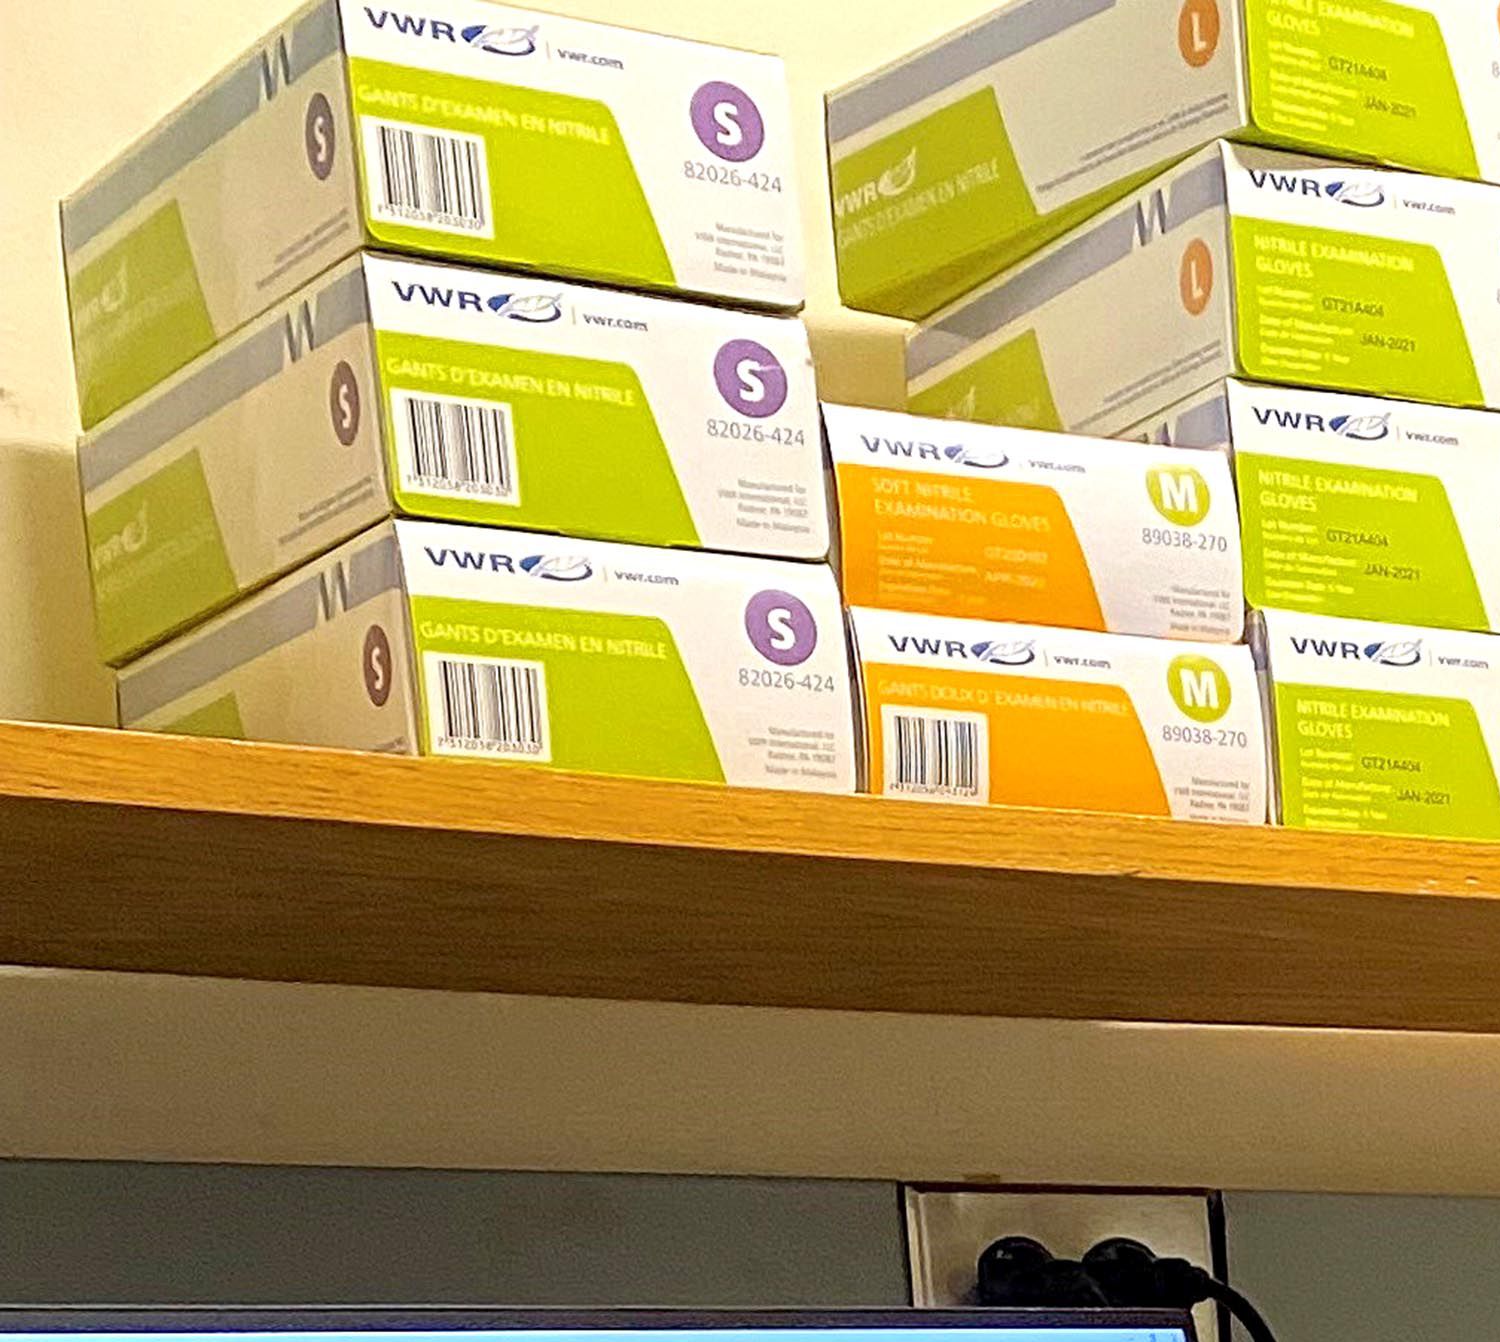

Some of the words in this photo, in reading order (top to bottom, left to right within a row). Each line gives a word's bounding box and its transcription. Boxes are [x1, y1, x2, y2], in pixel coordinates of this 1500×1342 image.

[363, 6, 456, 43] VWR
[557, 49, 624, 70] vwr.com
[1191, 4, 1207, 51] L
[357, 84, 418, 114] GANTS
[521, 113, 545, 132] EN
[547, 117, 611, 146] NITRILE
[711, 102, 743, 146] S
[315, 117, 326, 161] S
[683, 160, 783, 193] 82026-424
[1249, 169, 1322, 198] VWR
[835, 182, 877, 217] VWR
[1254, 235, 1309, 257] NITRILE
[1191, 254, 1203, 297] L
[1255, 256, 1313, 278] GLOVES
[391, 281, 484, 313] VWR
[583, 314, 648, 331] vwr.com
[386, 358, 446, 383] GANTS
[547, 379, 571, 397] EN
[574, 382, 636, 406] NITRILE
[736, 359, 765, 402] S
[339, 384, 351, 426] S
[1251, 406, 1325, 432] VWR
[707, 419, 805, 447] 82026-424
[860, 434, 941, 461] VWR
[872, 476, 910, 495] SOFT
[914, 479, 973, 503] NITRILE
[1159, 471, 1198, 513] M
[1258, 468, 1312, 492] NITRILE
[874, 499, 987, 526] EXAMINATION
[991, 509, 1051, 533] GLOVES
[1260, 492, 1317, 512] GLOVES
[1142, 527, 1228, 553] 89038-270
[424, 546, 515, 573] VWR
[614, 570, 679, 586] vwr.com
[420, 622, 479, 644] GANTS
[579, 636, 603, 653] EN
[607, 639, 666, 659] NITRILE
[767, 608, 795, 650] S
[889, 635, 966, 660] VWR
[1290, 637, 1360, 661] VWR
[371, 647, 383, 688] S
[738, 667, 835, 693] 82026-424
[1180, 668, 1219, 709] M
[1297, 699, 1348, 720] NITRILE
[1350, 704, 1450, 728] EXAMINATION
[1297, 720, 1353, 739] GLOVES
[1161, 725, 1248, 749] 89038-270
